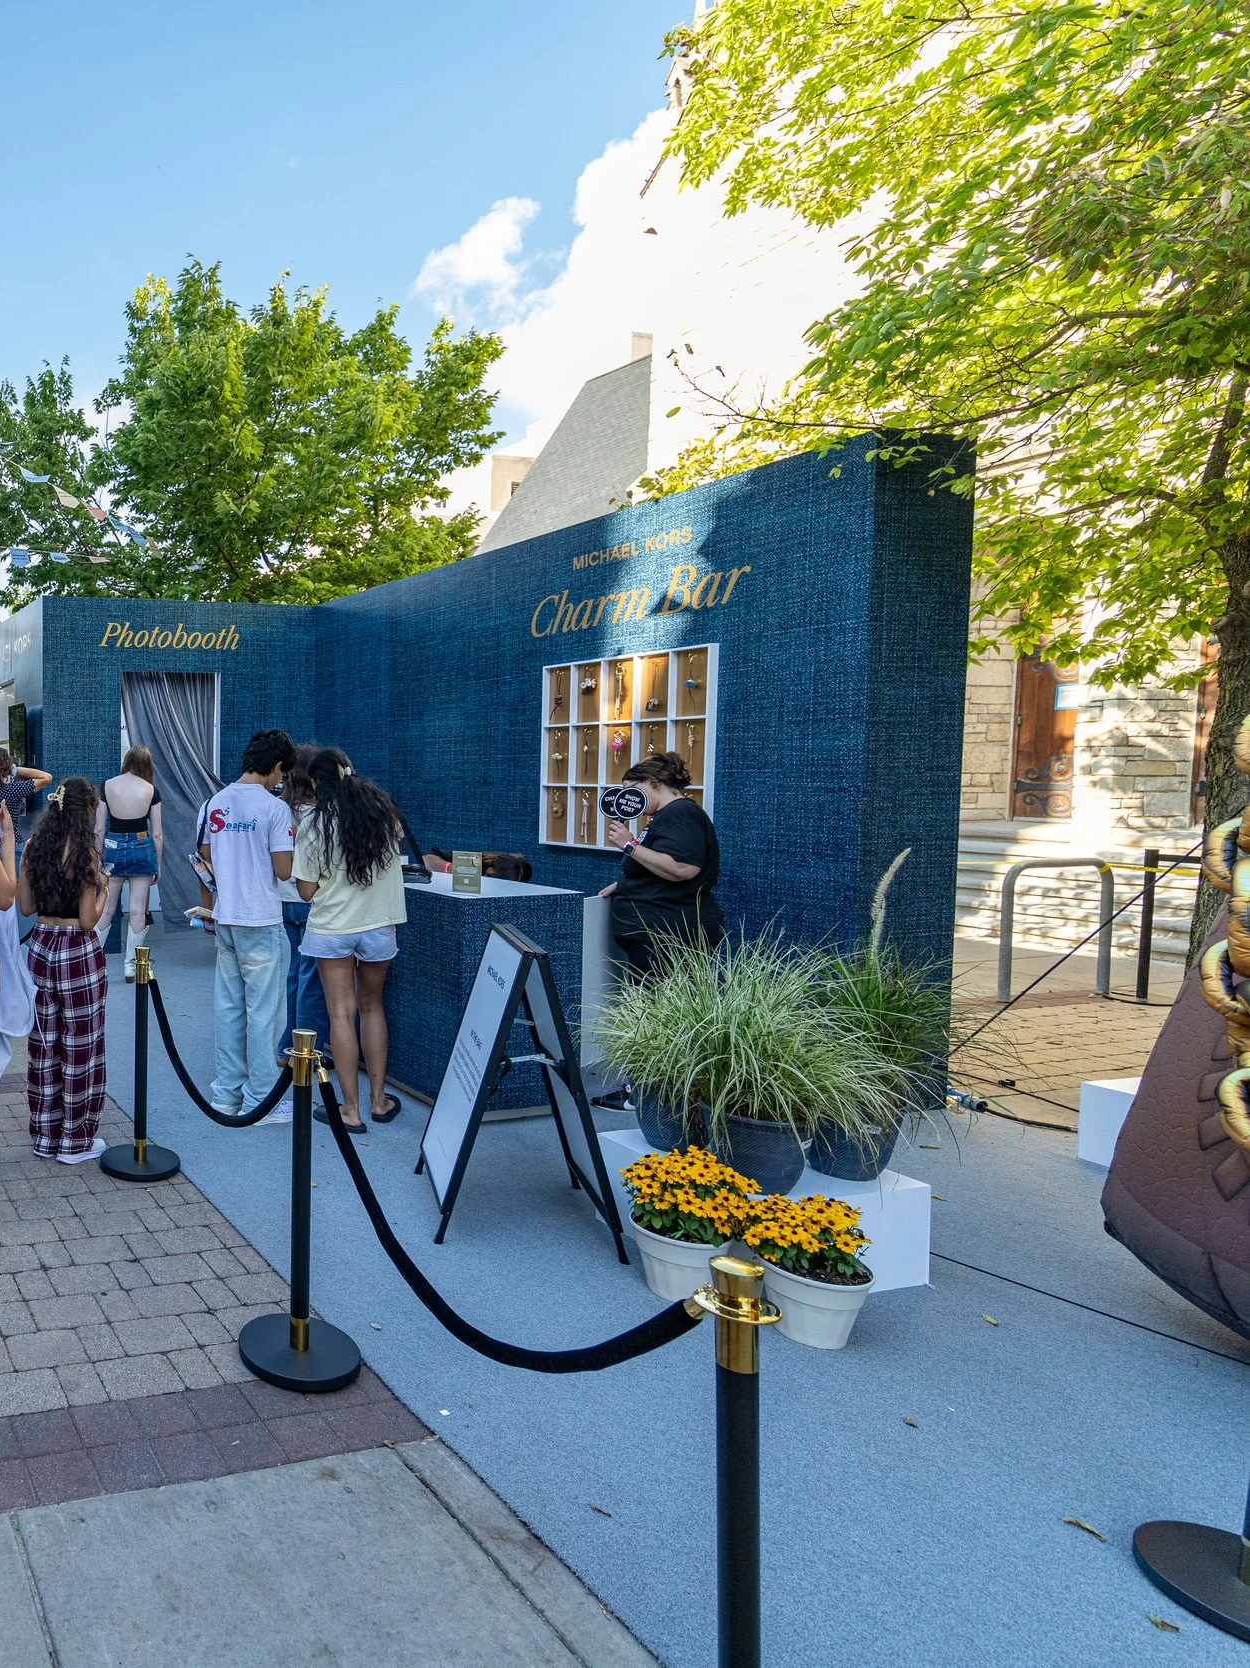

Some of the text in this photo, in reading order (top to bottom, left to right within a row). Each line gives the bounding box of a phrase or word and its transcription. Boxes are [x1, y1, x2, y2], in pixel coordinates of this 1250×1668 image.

[573, 526, 693, 571] MICHAEL KORS
[530, 564, 751, 638] Charm Bar
[99, 622, 240, 651] Photobooth
[620, 805, 635, 813] POST
[624, 793, 641, 802] SHOW
[627, 801, 642, 809] YOUR
[209, 808, 257, 834] Seafari
